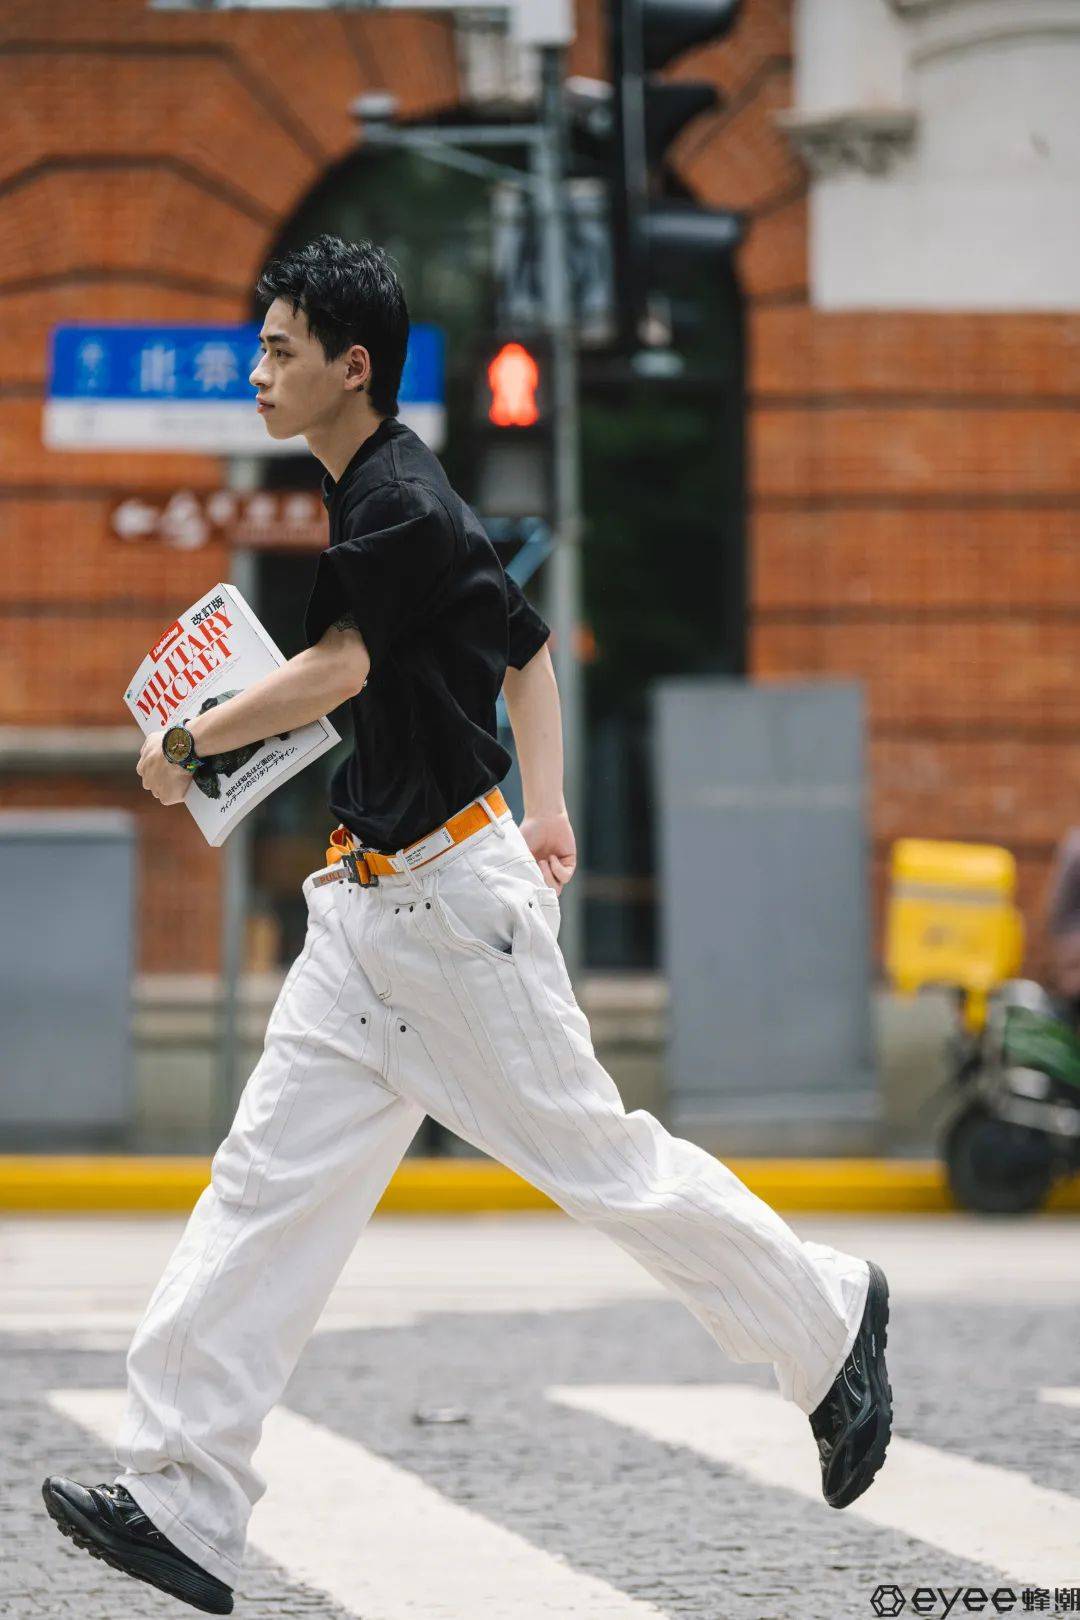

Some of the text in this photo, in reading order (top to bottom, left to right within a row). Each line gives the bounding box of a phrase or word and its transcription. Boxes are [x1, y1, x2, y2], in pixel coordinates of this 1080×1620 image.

[190, 595, 225, 626] 改訂版
[134, 604, 234, 721] MILITARY
[160, 632, 233, 727] JACKET
